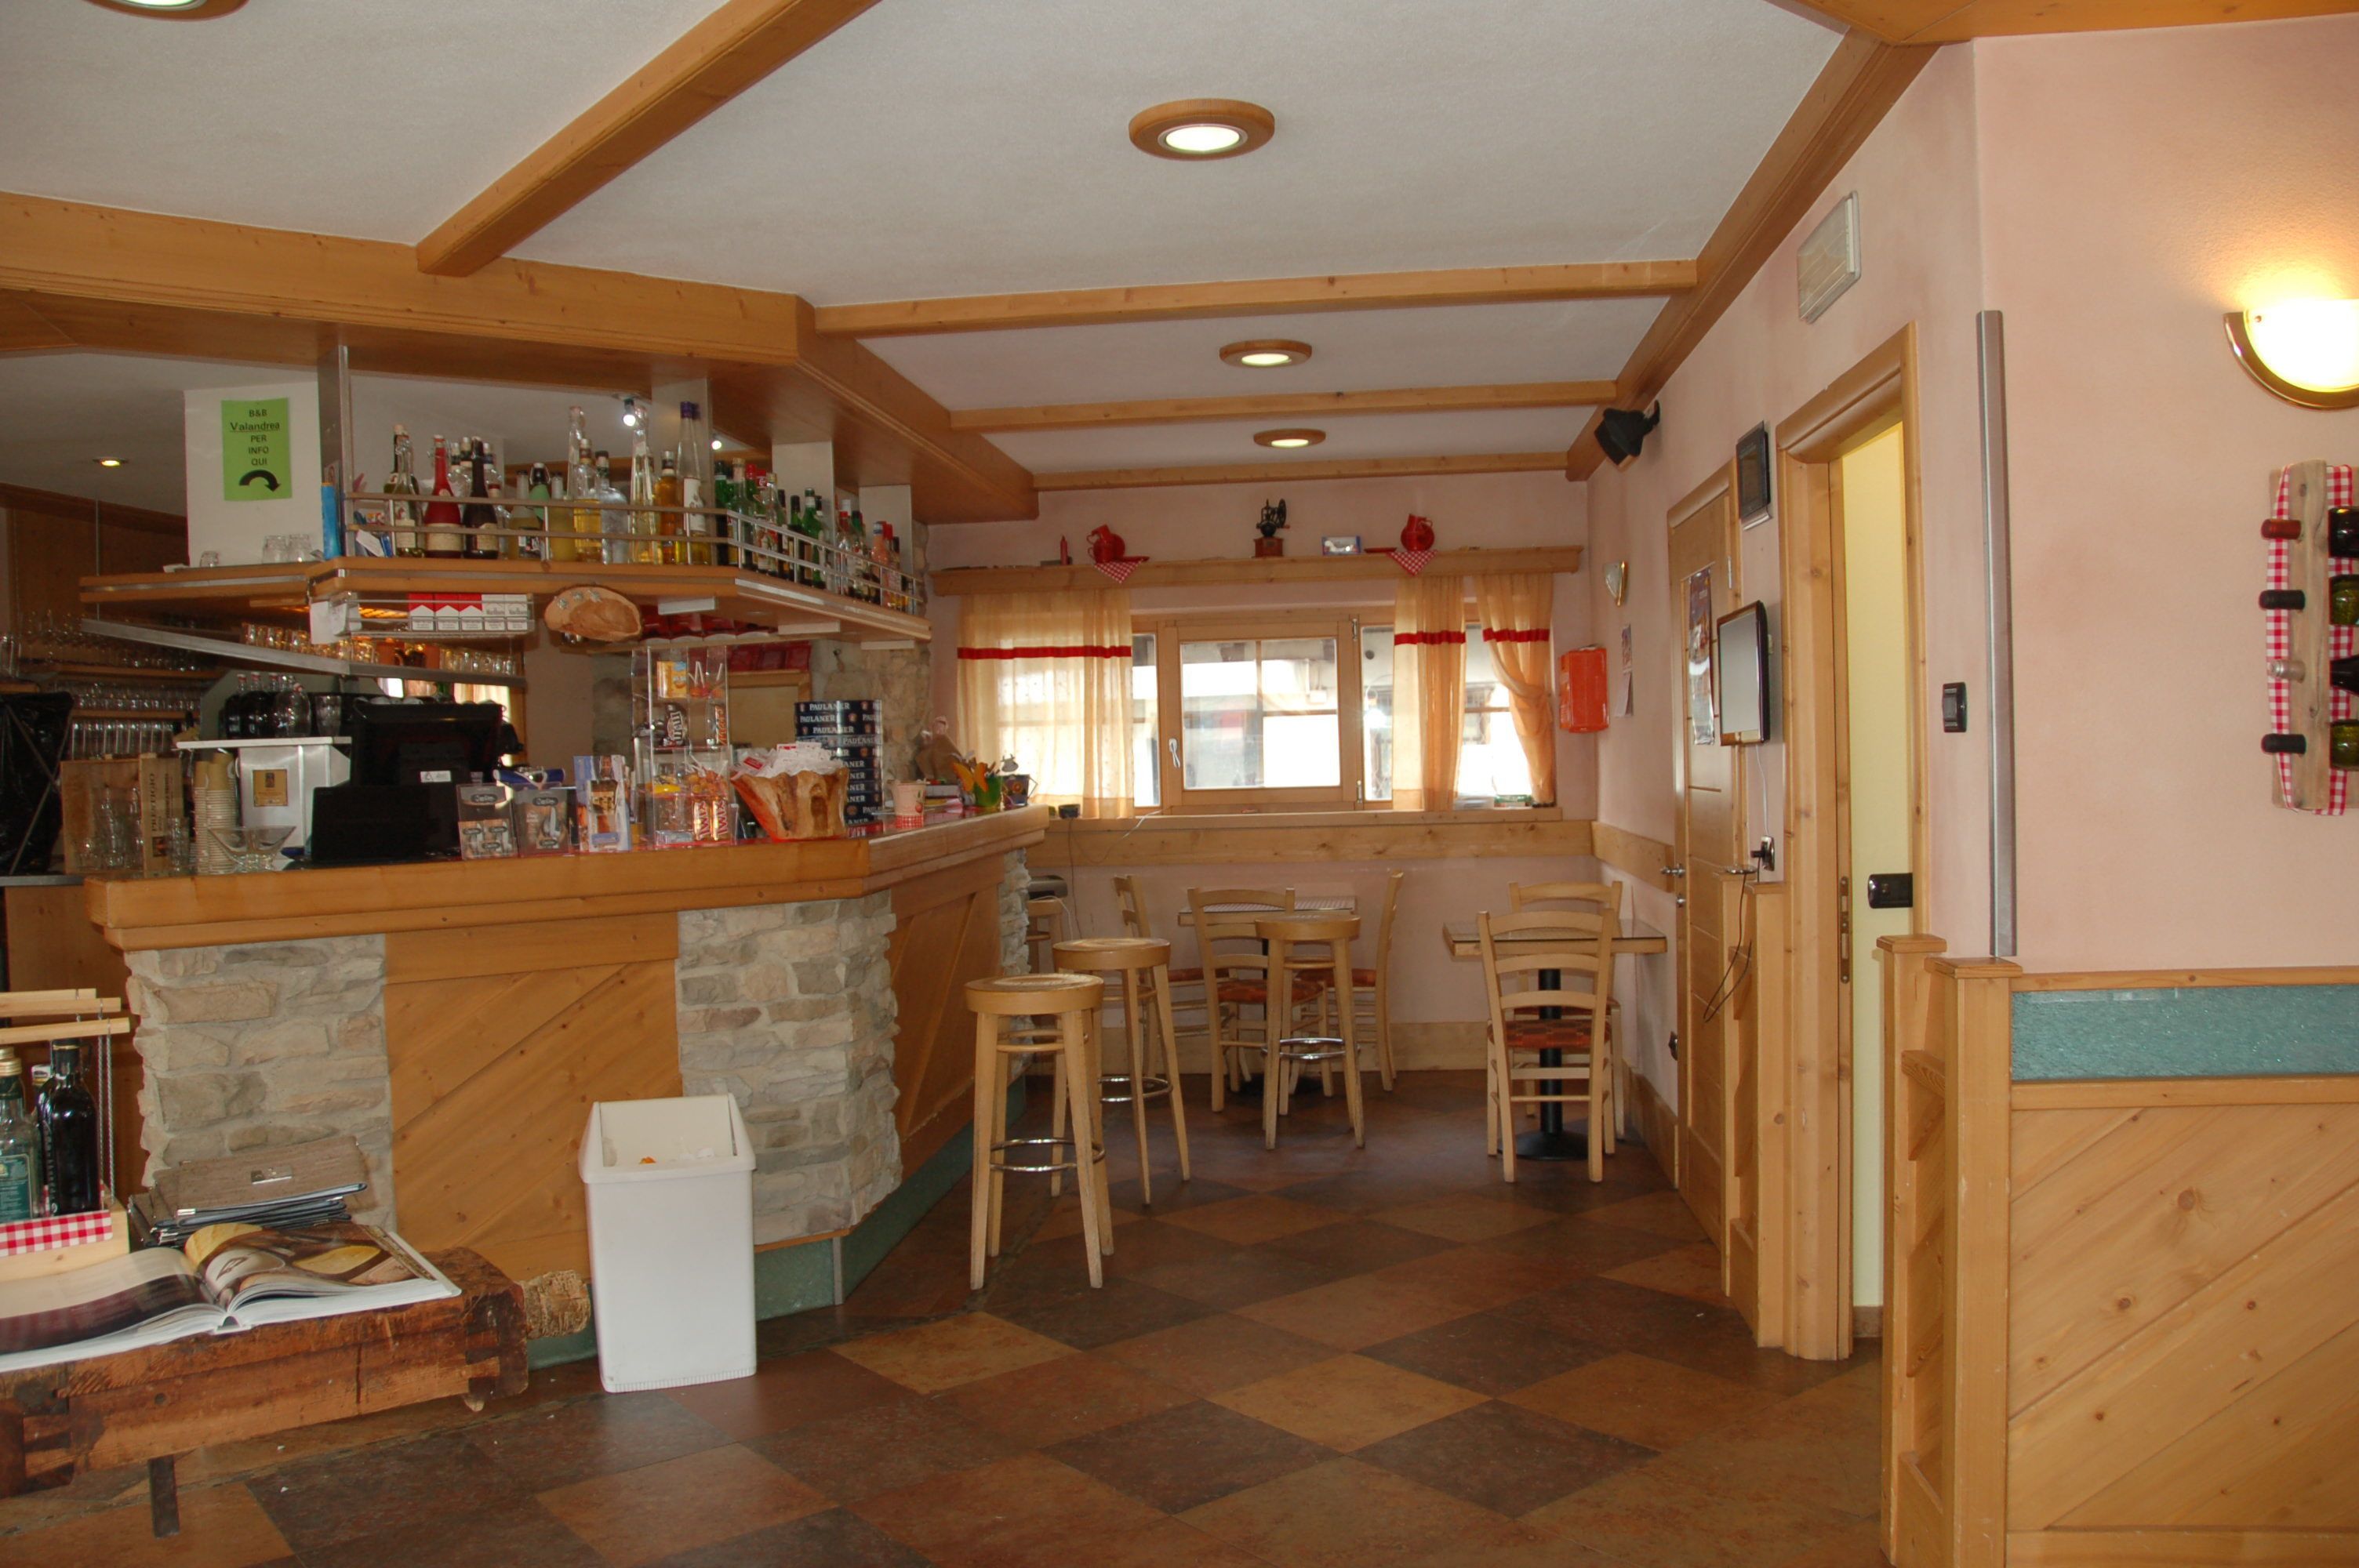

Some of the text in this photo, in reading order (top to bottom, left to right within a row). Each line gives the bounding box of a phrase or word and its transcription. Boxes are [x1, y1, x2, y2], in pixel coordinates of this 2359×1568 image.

[249, 408, 267, 418] B&B
[230, 422, 280, 431] Valandrea
[250, 434, 267, 443] PER
[248, 446, 269, 455] INFO
